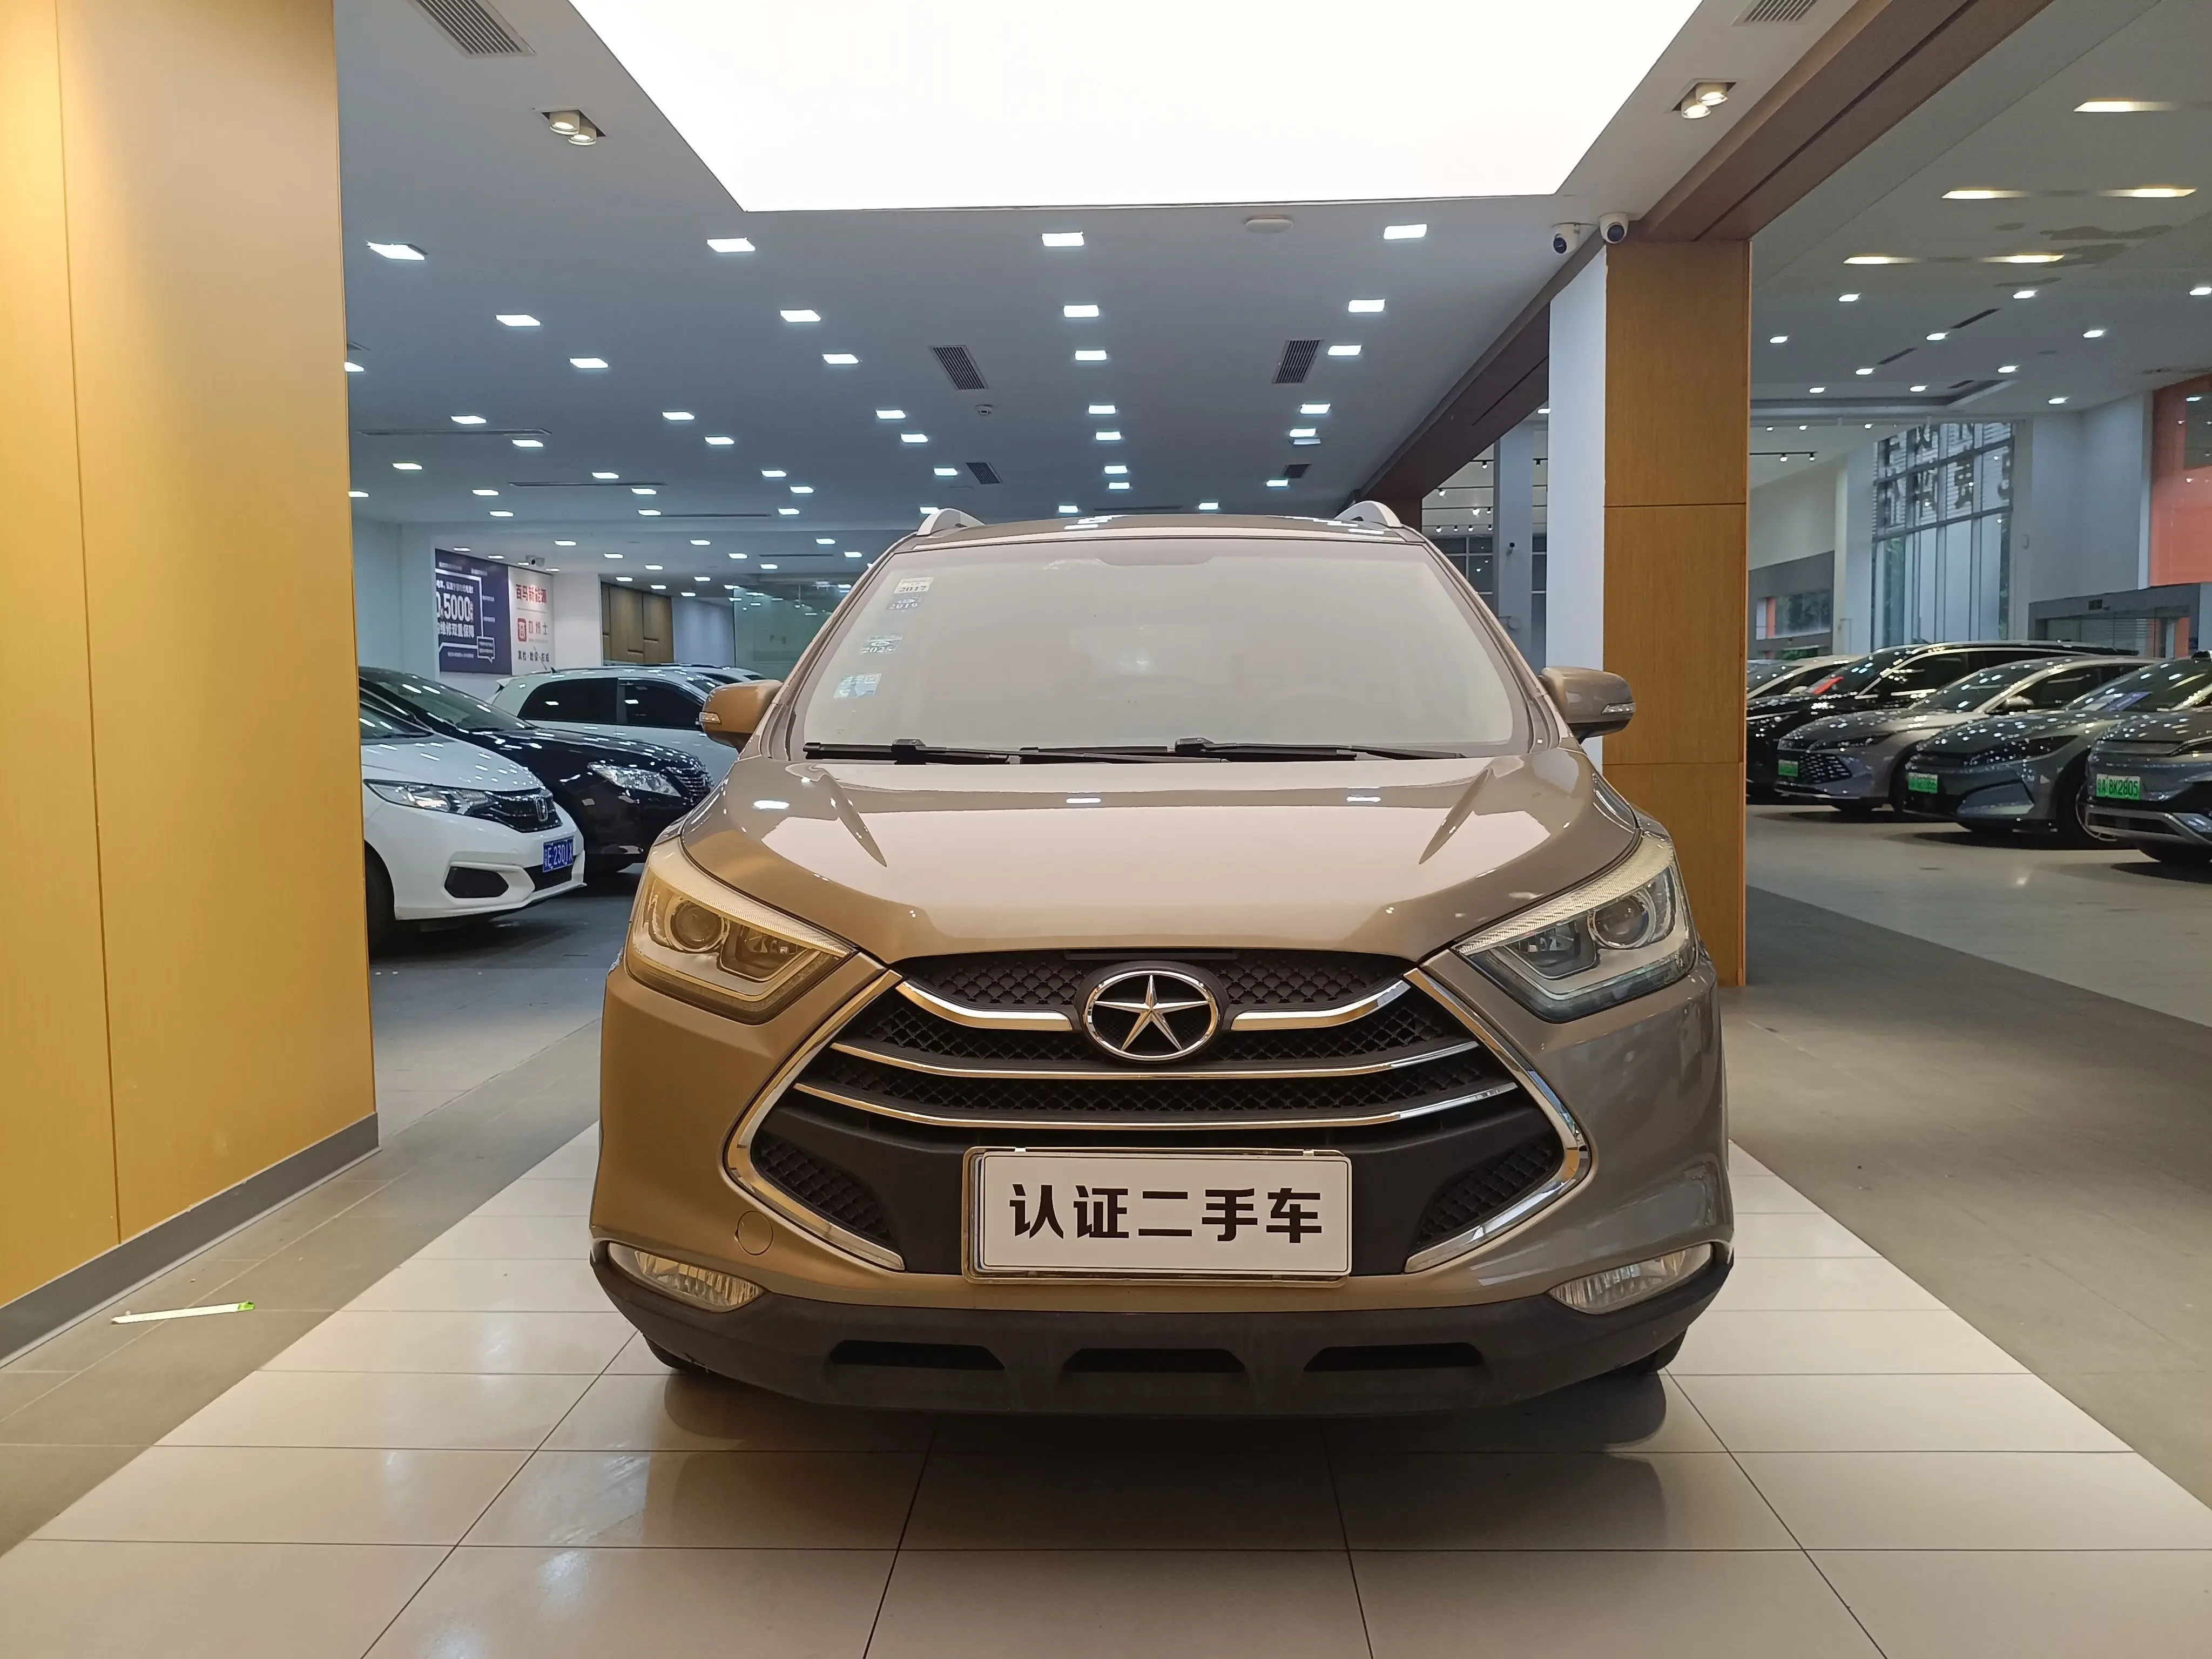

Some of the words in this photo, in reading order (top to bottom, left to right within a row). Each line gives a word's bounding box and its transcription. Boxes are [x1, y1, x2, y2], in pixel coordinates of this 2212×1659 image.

[443, 593, 470, 622] 5000
[516, 584, 547, 603] 百马新能源
[1009, 1183, 1322, 1244] 认证二手车
